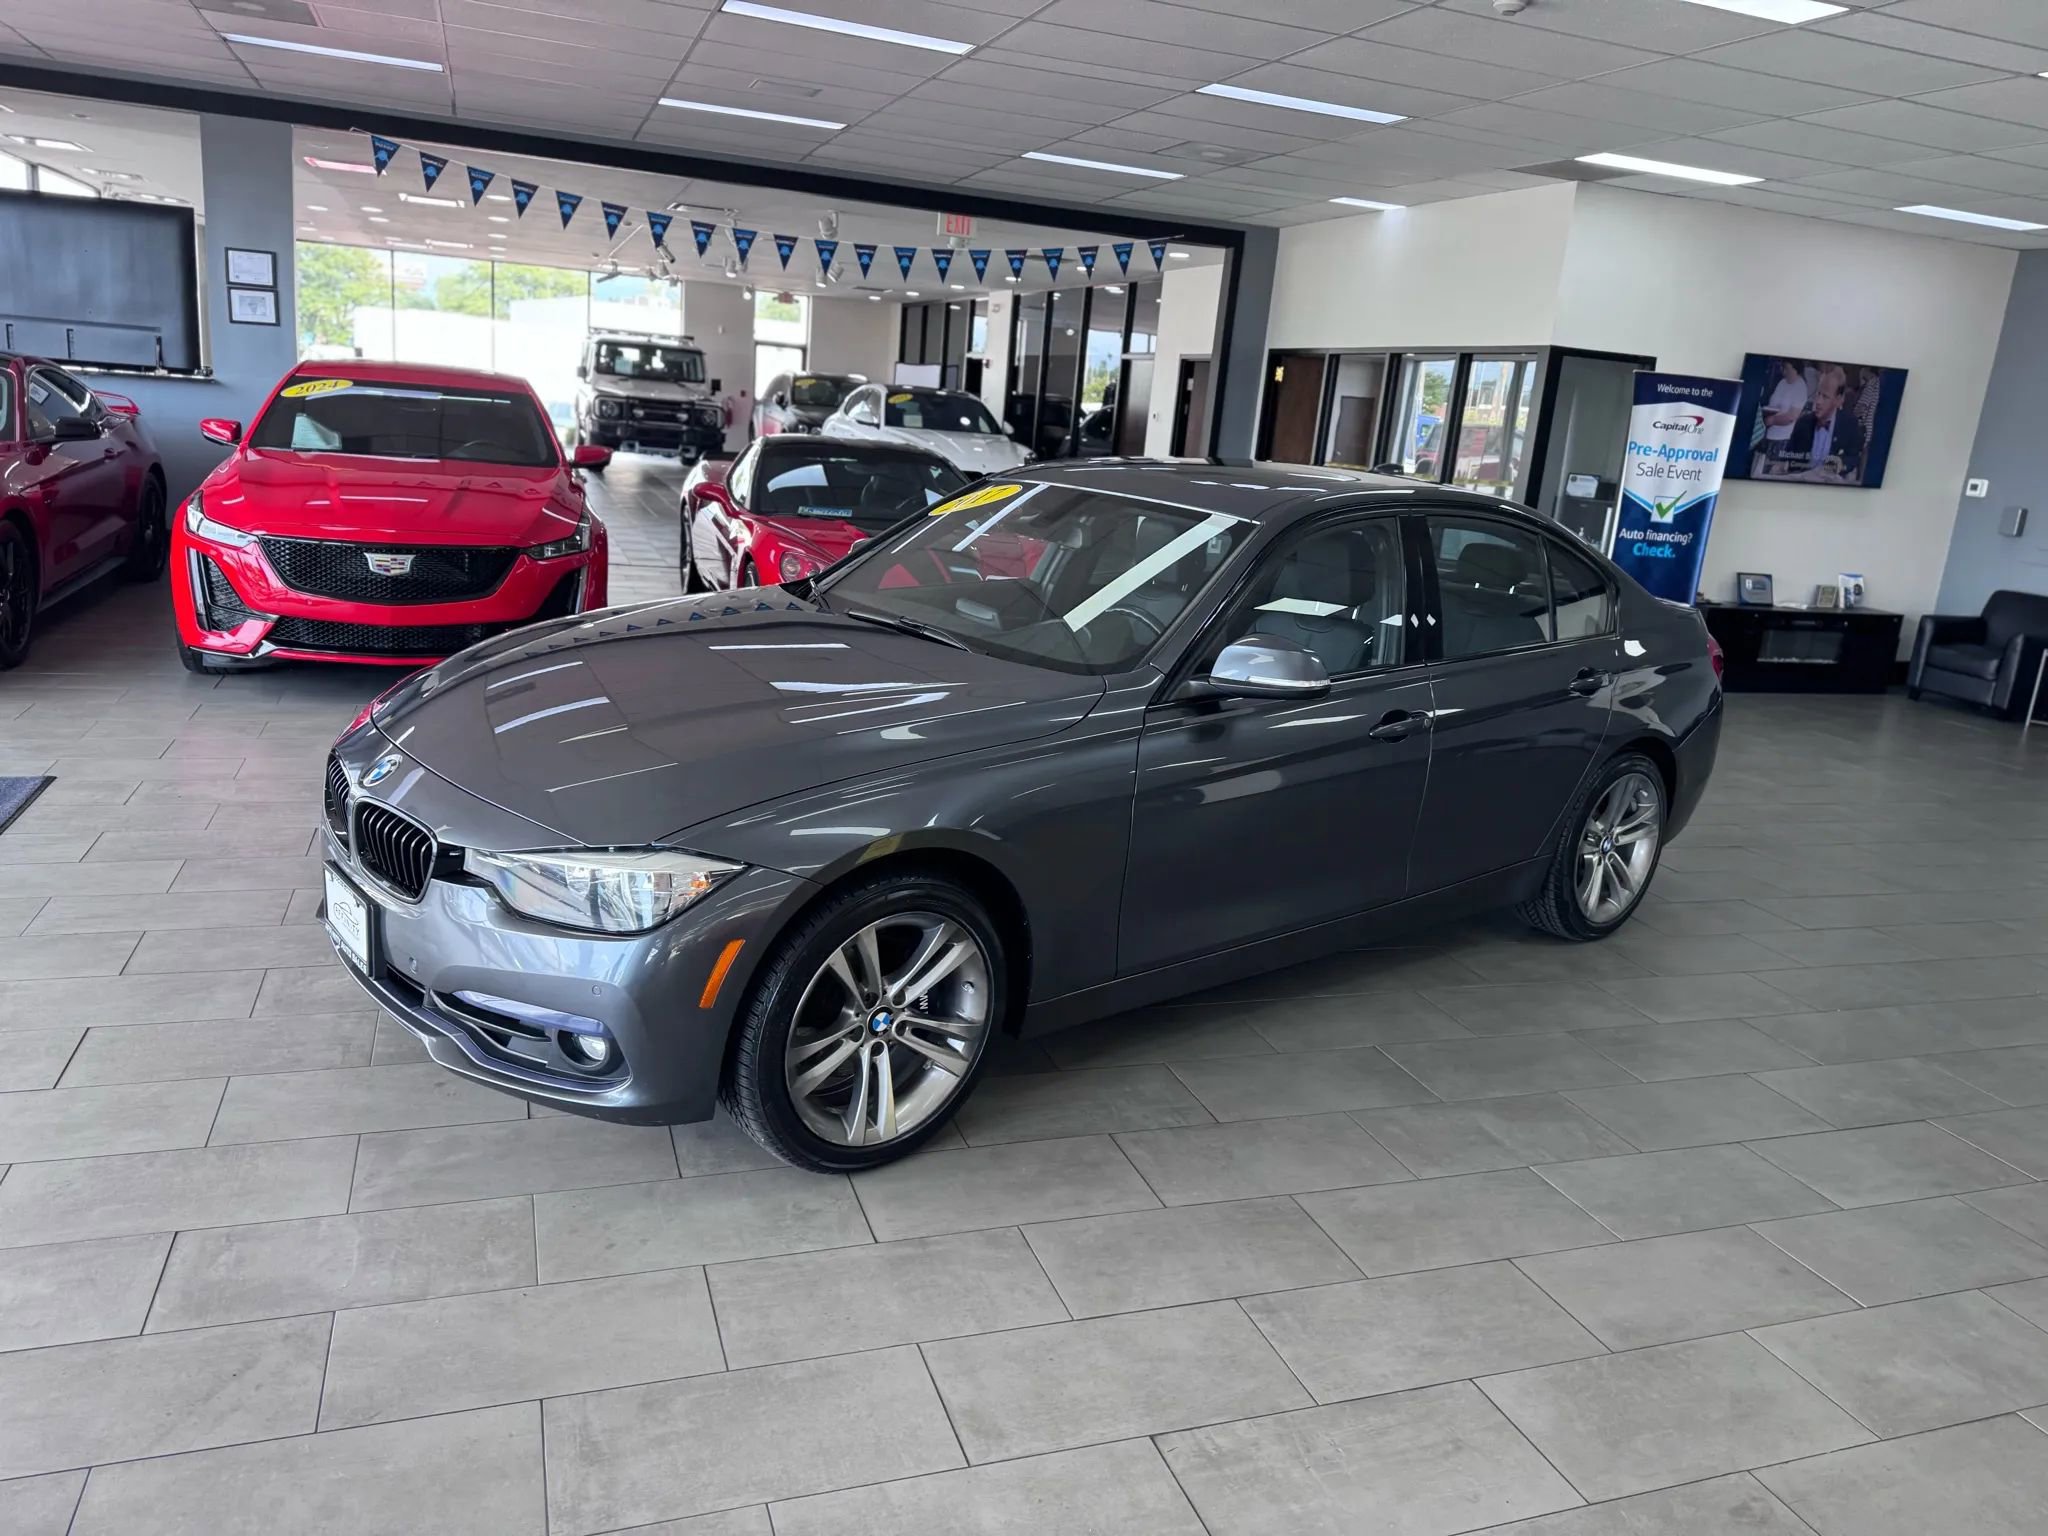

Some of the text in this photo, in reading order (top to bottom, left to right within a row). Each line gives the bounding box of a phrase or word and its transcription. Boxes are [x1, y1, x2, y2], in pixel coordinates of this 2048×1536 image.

[946, 213, 973, 236] EXIT
[1657, 383, 1690, 395] Welcome
[1701, 389, 1714, 398] the
[1628, 441, 1719, 462] Pre-Approval
[1636, 462, 1703, 481] Sale Event
[1619, 528, 1693, 546] Auto financing?
[1632, 543, 1676, 559] Check.
